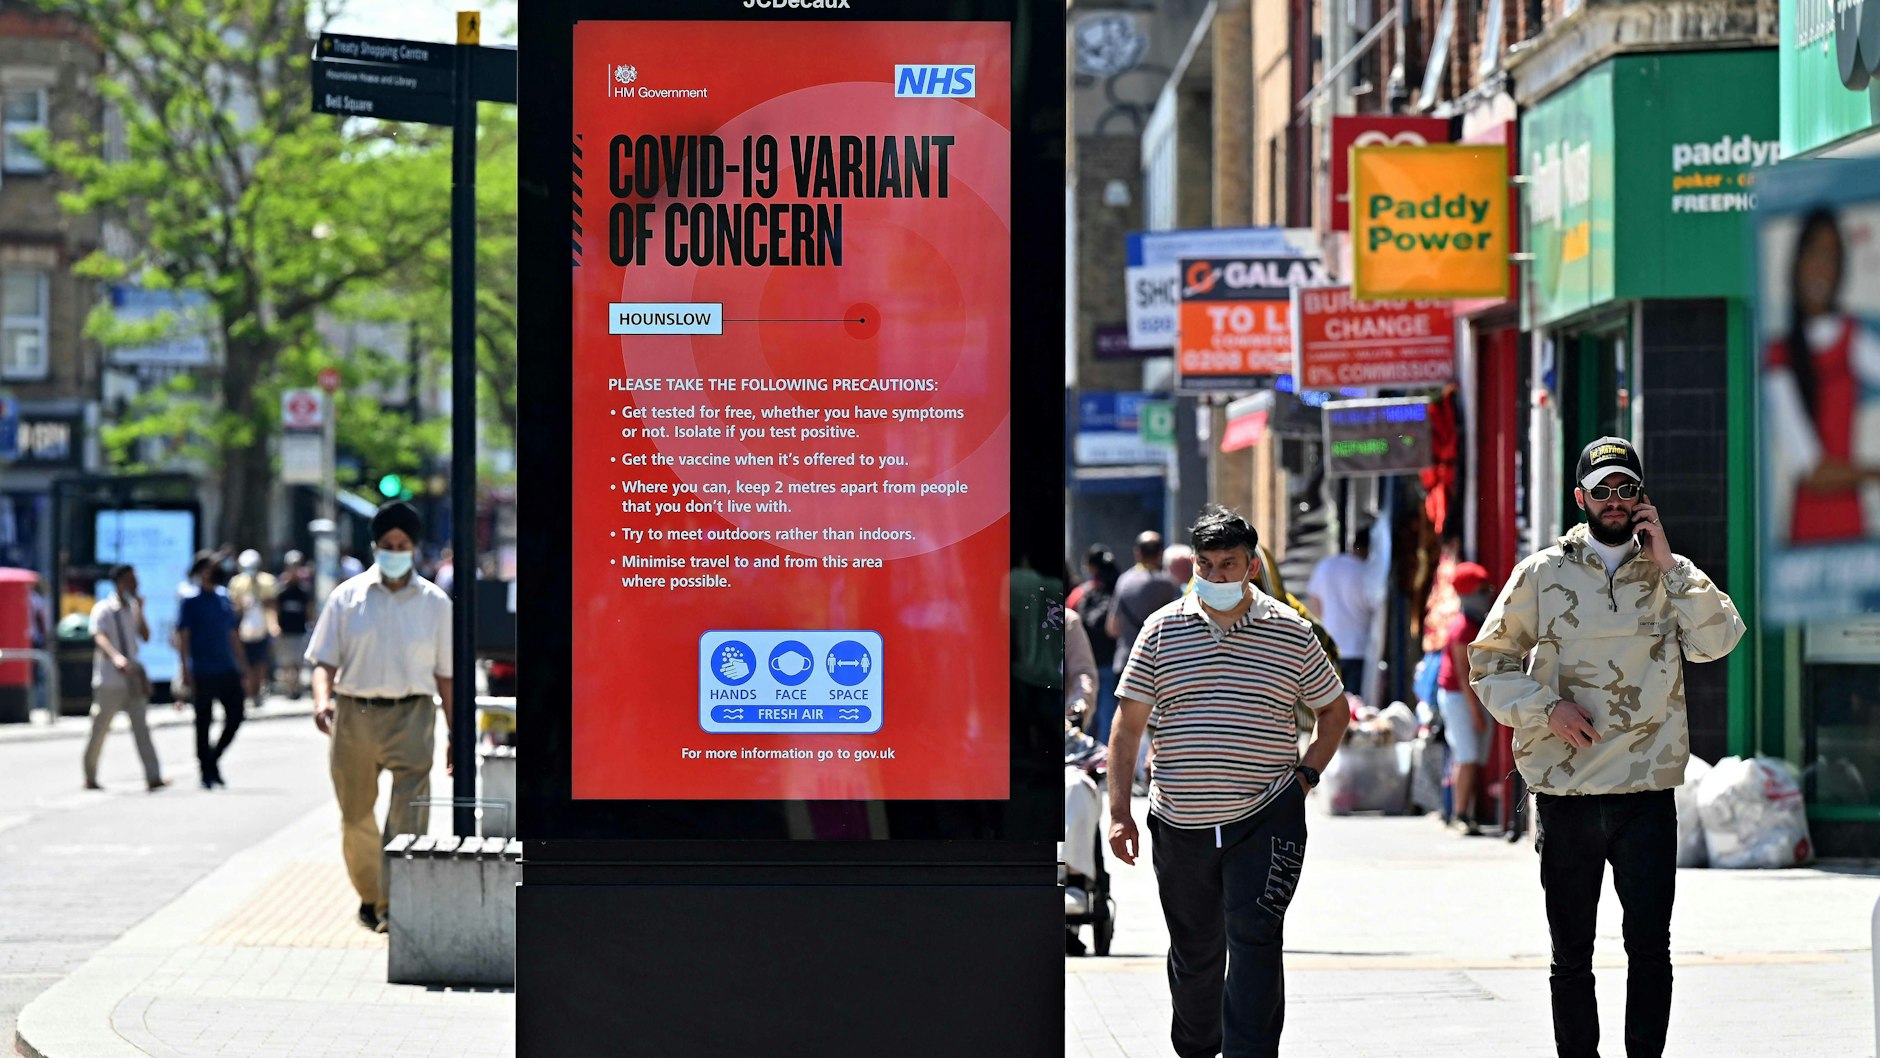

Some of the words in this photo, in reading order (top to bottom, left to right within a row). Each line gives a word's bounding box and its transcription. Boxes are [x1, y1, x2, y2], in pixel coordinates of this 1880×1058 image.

[333, 38, 359, 57] Treaty
[360, 42, 398, 61] Shopping
[399, 45, 429, 62] Centre
[898, 67, 975, 95] NHS
[614, 86, 635, 98] HM
[637, 86, 708, 98] Government
[325, 93, 342, 109] Bell
[343, 95, 374, 113] Square
[609, 135, 778, 199] COVID-19
[789, 135, 955, 199] VARIANT
[1672, 171, 1723, 192] poker
[1369, 193, 1490, 224] Paddy
[609, 203, 657, 267] OF
[664, 203, 843, 267] CONCERN
[1368, 226, 1492, 252] Power
[619, 312, 712, 326] HOUNSLOW
[1206, 305, 1255, 333] TO
[1324, 313, 1432, 340] CHANGE
[1337, 361, 1454, 384] COMMISSION
[608, 378, 662, 391] PLEASE
[665, 378, 704, 391] TAKE
[707, 378, 737, 391] THE
[741, 378, 828, 391] FOLLOWING
[832, 378, 938, 392] PRECAUTIONS:
[621, 405, 648, 419] Get
[650, 404, 695, 419] tested
[699, 404, 721, 419] for
[724, 404, 756, 421] free,
[760, 405, 821, 419] whether
[824, 408, 850, 423] you
[854, 405, 888, 419] have
[891, 406, 965, 423] symptoms
[621, 427, 638, 438] or
[641, 425, 670, 438] not.
[674, 424, 722, 438] Isolate
[725, 424, 736, 438] if
[739, 428, 765, 442] you
[769, 425, 797, 438] test
[800, 424, 860, 442] positive.
[621, 453, 647, 466] Get
[650, 452, 675, 466] the
[678, 452, 731, 466] vaccine
[734, 452, 774, 466] when
[778, 452, 800, 466] it’s
[803, 452, 855, 466] offered
[858, 453, 875, 466] to
[878, 455, 909, 470] you.
[621, 479, 668, 493] Where
[672, 483, 698, 497] you
[702, 483, 731, 495] can,
[736, 479, 771, 497] keep
[774, 480, 784, 494] 2
[788, 481, 837, 494] metres
[840, 481, 879, 497] apart
[882, 479, 916, 494] from
[920, 479, 969, 497] people
[621, 499, 652, 513] that
[655, 502, 681, 516] you
[685, 499, 724, 513] don’t
[727, 499, 752, 513] live
[755, 499, 792, 513] with.
[621, 527, 644, 544] Try
[647, 528, 663, 541] to
[667, 528, 703, 541] meet
[706, 527, 772, 541] outdoors
[775, 526, 819, 541] rather
[821, 526, 855, 541] than
[859, 526, 916, 541] indoors.
[622, 554, 686, 568] Minimise
[689, 554, 730, 568] travel
[733, 555, 750, 568] to
[753, 554, 780, 568] and
[783, 554, 818, 568] from
[821, 554, 849, 568] this
[852, 557, 883, 568] area
[621, 573, 666, 588] where
[670, 574, 731, 591] possible.
[710, 689, 757, 700] HANDS
[775, 689, 807, 700] FACE
[829, 689, 869, 700] SPACE
[758, 708, 798, 720] FRESH
[801, 708, 824, 720] AIR
[681, 747, 702, 759] For
[705, 749, 738, 759] more
[741, 746, 814, 759] information
[817, 750, 834, 762] go
[836, 748, 851, 759] to
[853, 747, 896, 762] gov.uk
[1256, 836, 1305, 919] NIKE
